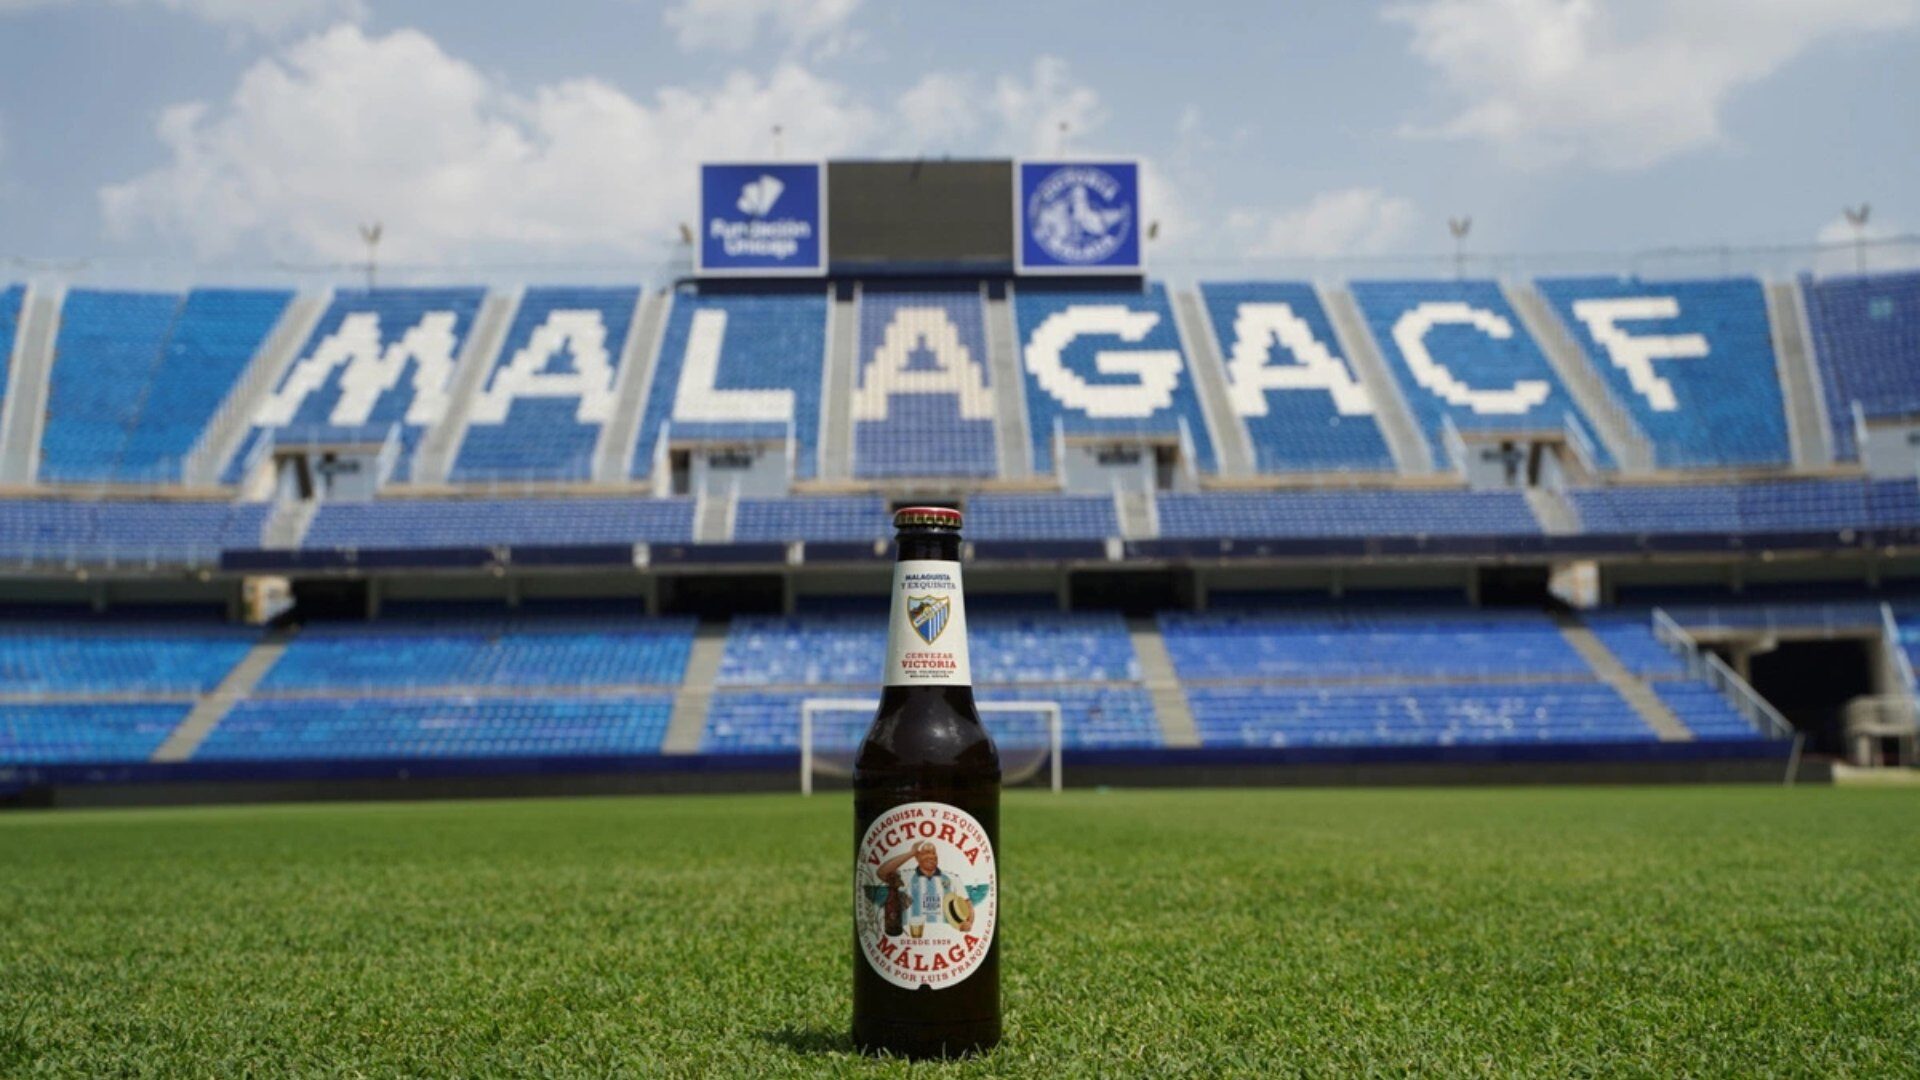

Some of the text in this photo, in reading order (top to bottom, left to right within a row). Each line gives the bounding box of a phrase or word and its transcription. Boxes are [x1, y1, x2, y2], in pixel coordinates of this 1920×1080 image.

[905, 573, 951, 581] MALAGUISTA
[908, 582, 957, 590] EXQUISITA
[902, 660, 957, 668] VICTORIA
[867, 808, 991, 863] MALAGUISTA Y EXQUISITA
[868, 820, 980, 866] VICTORIA
[876, 934, 980, 972] MÁLAGA
[894, 970, 917, 982] POR
[921, 973, 949, 983] LUIS
